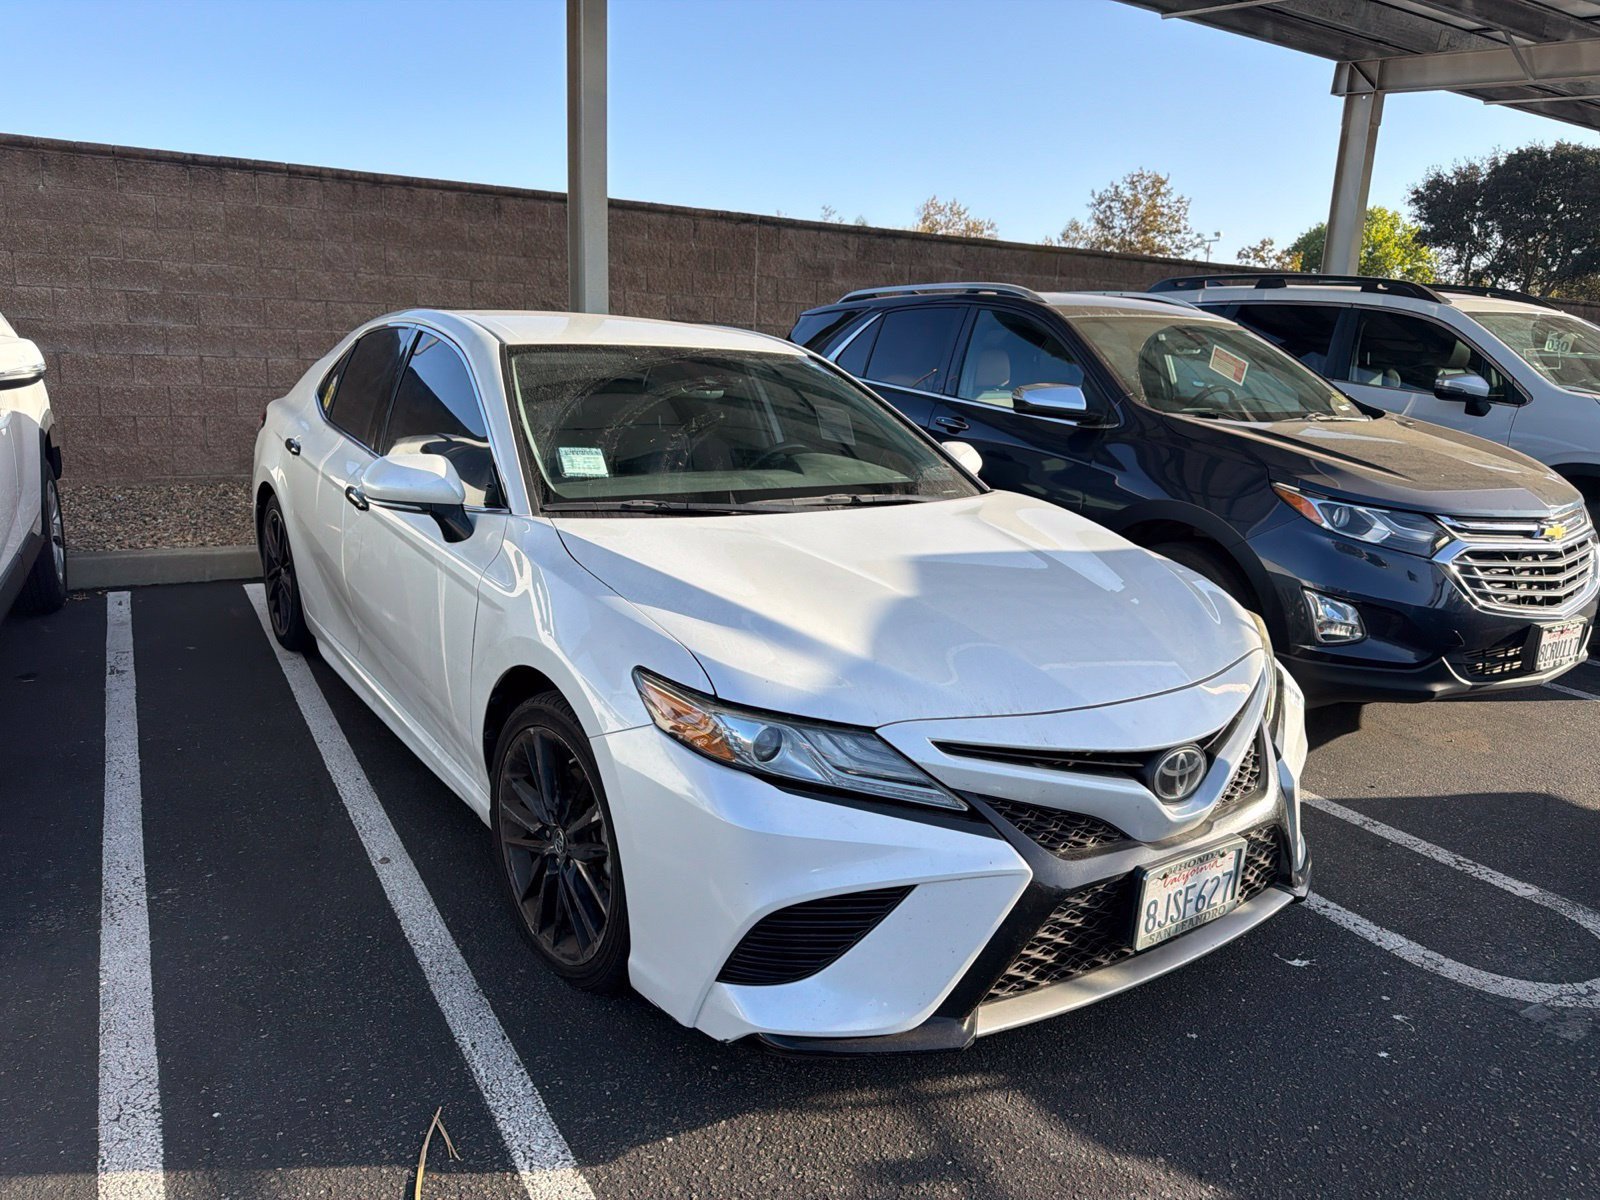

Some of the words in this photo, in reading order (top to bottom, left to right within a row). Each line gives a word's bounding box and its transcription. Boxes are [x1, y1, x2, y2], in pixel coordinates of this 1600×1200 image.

[1547, 339, 1570, 352] 030
[1539, 637, 1579, 663] 8CRU117
[1163, 860, 1222, 888] California
[1144, 870, 1234, 934] 8JSF627
[1149, 927, 1172, 944] SAN
[1173, 905, 1226, 933] LEANDRO
